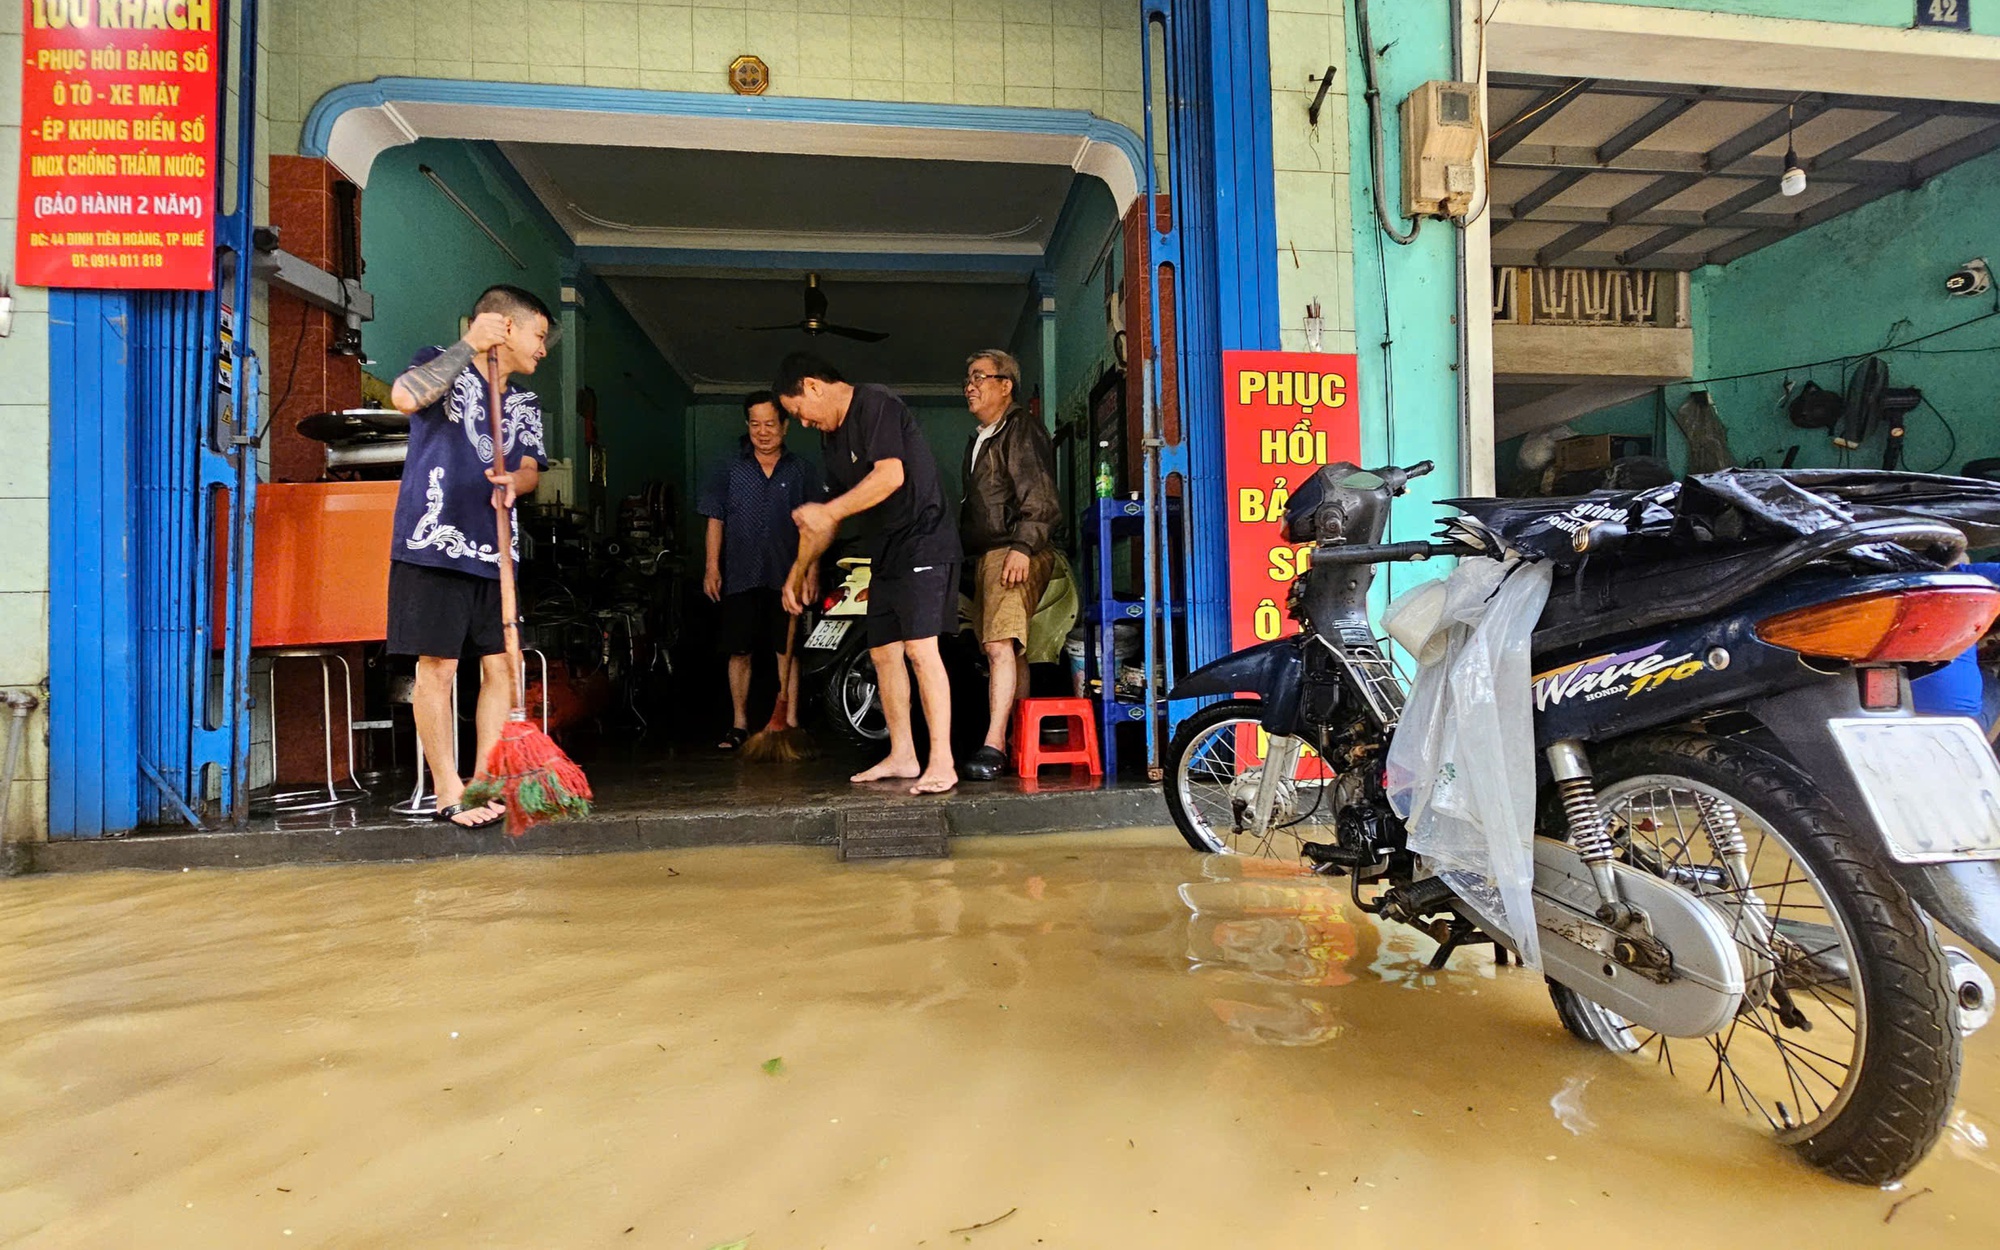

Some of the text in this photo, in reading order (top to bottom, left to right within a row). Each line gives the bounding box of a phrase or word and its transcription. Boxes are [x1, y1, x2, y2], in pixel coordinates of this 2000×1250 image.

[1928, 0, 1958, 22] 42
[38, 49, 87, 75] PHỤC
[91, 42, 122, 71] HỒI
[126, 43, 177, 72] BẢNG
[183, 43, 209, 73] SỐ
[53, 79, 66, 106] Ô
[70, 79, 92, 106] TÔ
[110, 84, 134, 106] XE
[138, 81, 180, 107] MÁY
[42, 116, 65, 142] ÉP
[68, 119, 128, 141] KHUNG
[133, 112, 175, 142] BIỂN
[180, 114, 205, 143] SỐ
[31, 147, 205, 178] INOX CHỐNG THẤM NƯỚC
[34, 191, 202, 218] (BẢO HÀNH 2 NĂM)
[51, 233, 64, 247] 44
[96, 230, 120, 247] TIÊN
[166, 233, 180, 247] TP
[182, 229, 205, 247] HUẾ
[90, 254, 117, 267] 0914
[120, 254, 139, 267] 011
[142, 254, 163, 267] 818
[1239, 370, 1347, 414] PHỤC
[1261, 418, 1328, 465] HỒI
[1239, 476, 1290, 523] BẢ
[1532, 652, 1704, 712] Wave 110
[1585, 684, 1629, 702] HONDA
